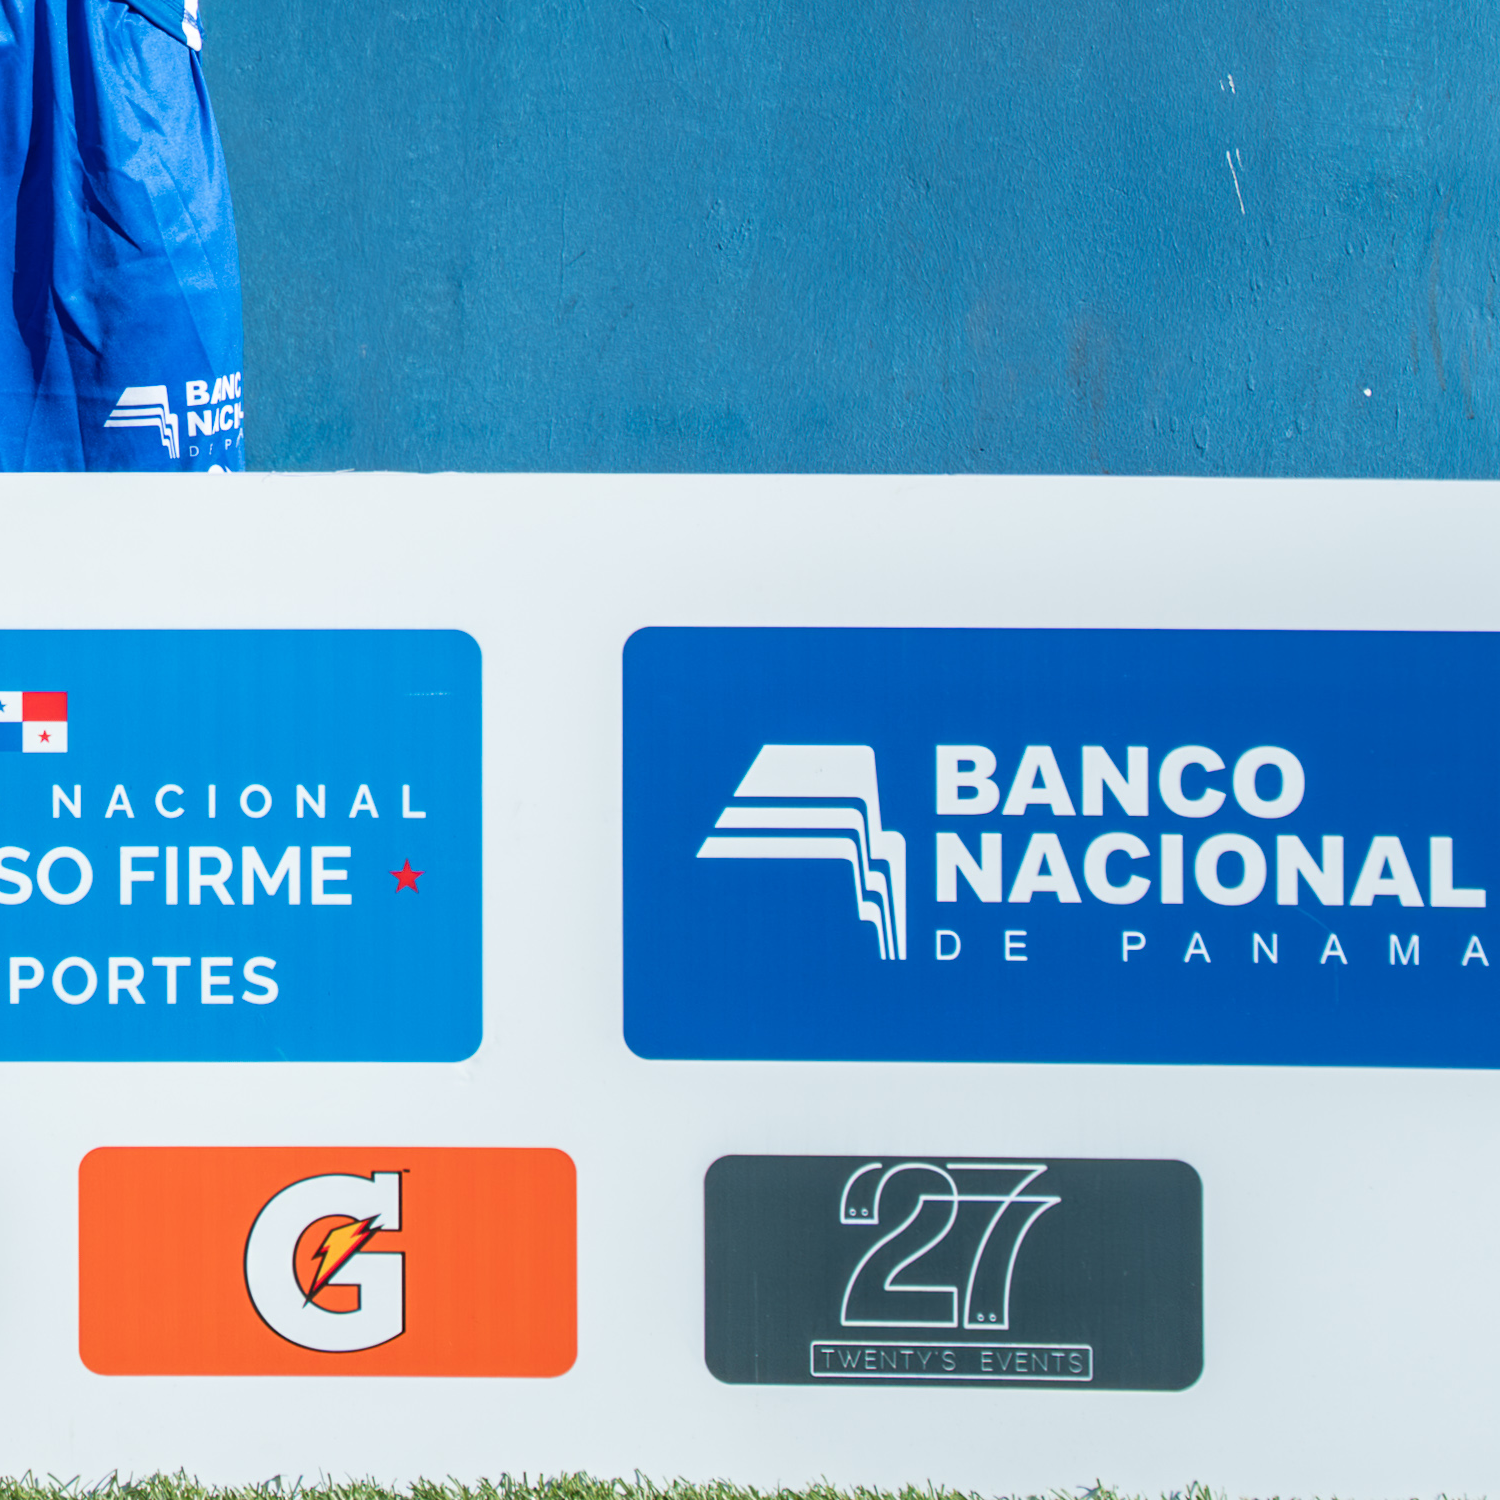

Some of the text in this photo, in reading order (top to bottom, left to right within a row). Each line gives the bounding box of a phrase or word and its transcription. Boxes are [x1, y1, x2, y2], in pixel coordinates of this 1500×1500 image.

[186, 402, 245, 437] NACI
[52, 783, 427, 819] NACIONAL
[936, 745, 1305, 819] BANCO
[119, 846, 352, 906] FIRME
[936, 832, 1486, 908] NACIONAL
[936, 930, 1490, 967] DE PANAMA
[243, 1170, 406, 1353] G
[820, 1348, 1084, 1374] TWENTY'S EVENTS
